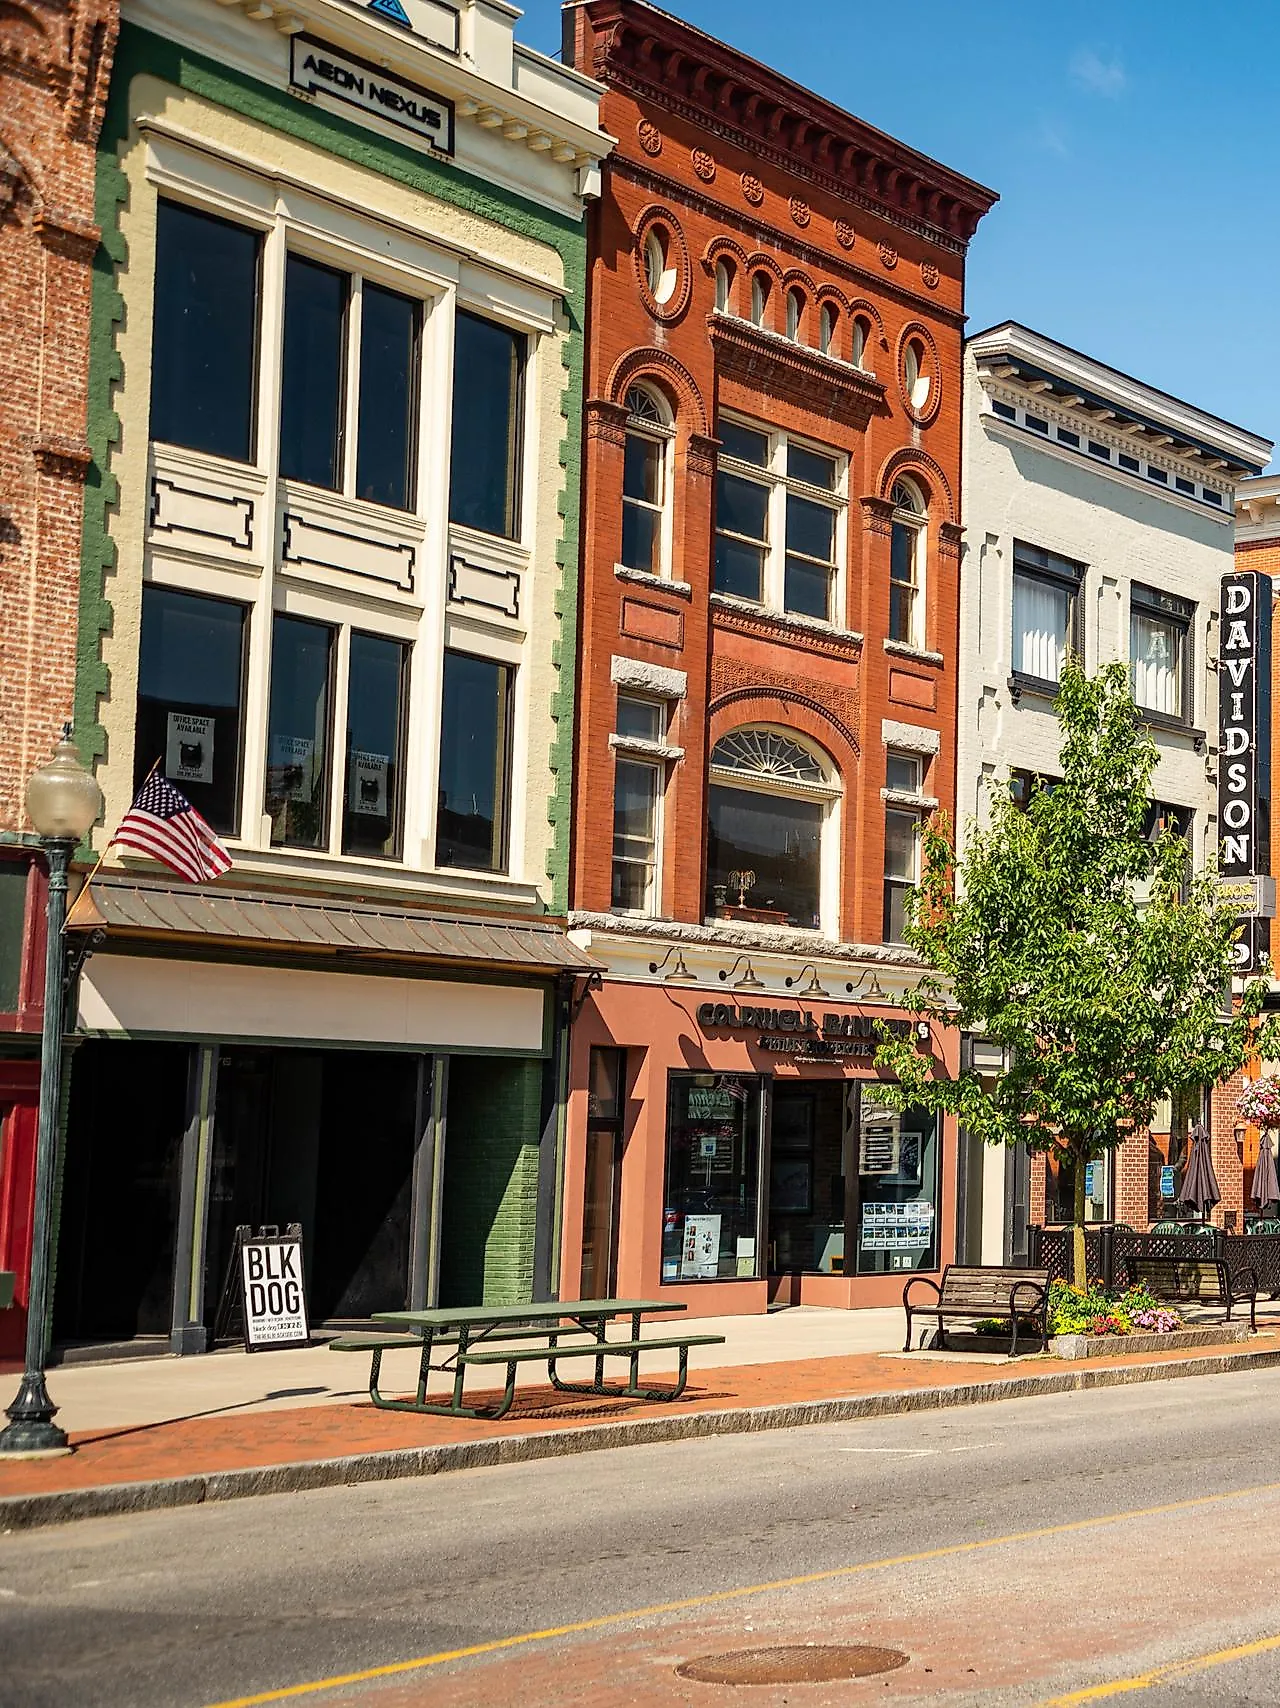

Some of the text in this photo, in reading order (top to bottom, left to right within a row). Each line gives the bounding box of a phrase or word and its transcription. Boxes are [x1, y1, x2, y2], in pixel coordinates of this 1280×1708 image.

[303, 54, 441, 130] AEON NEXUS
[176, 724, 207, 735] AVAILABLE
[1223, 585, 1251, 864] DAVIDSON
[696, 1003, 816, 1033] COLDWELL
[248, 1245, 297, 1281] BLK
[250, 1281, 300, 1317] DOG
